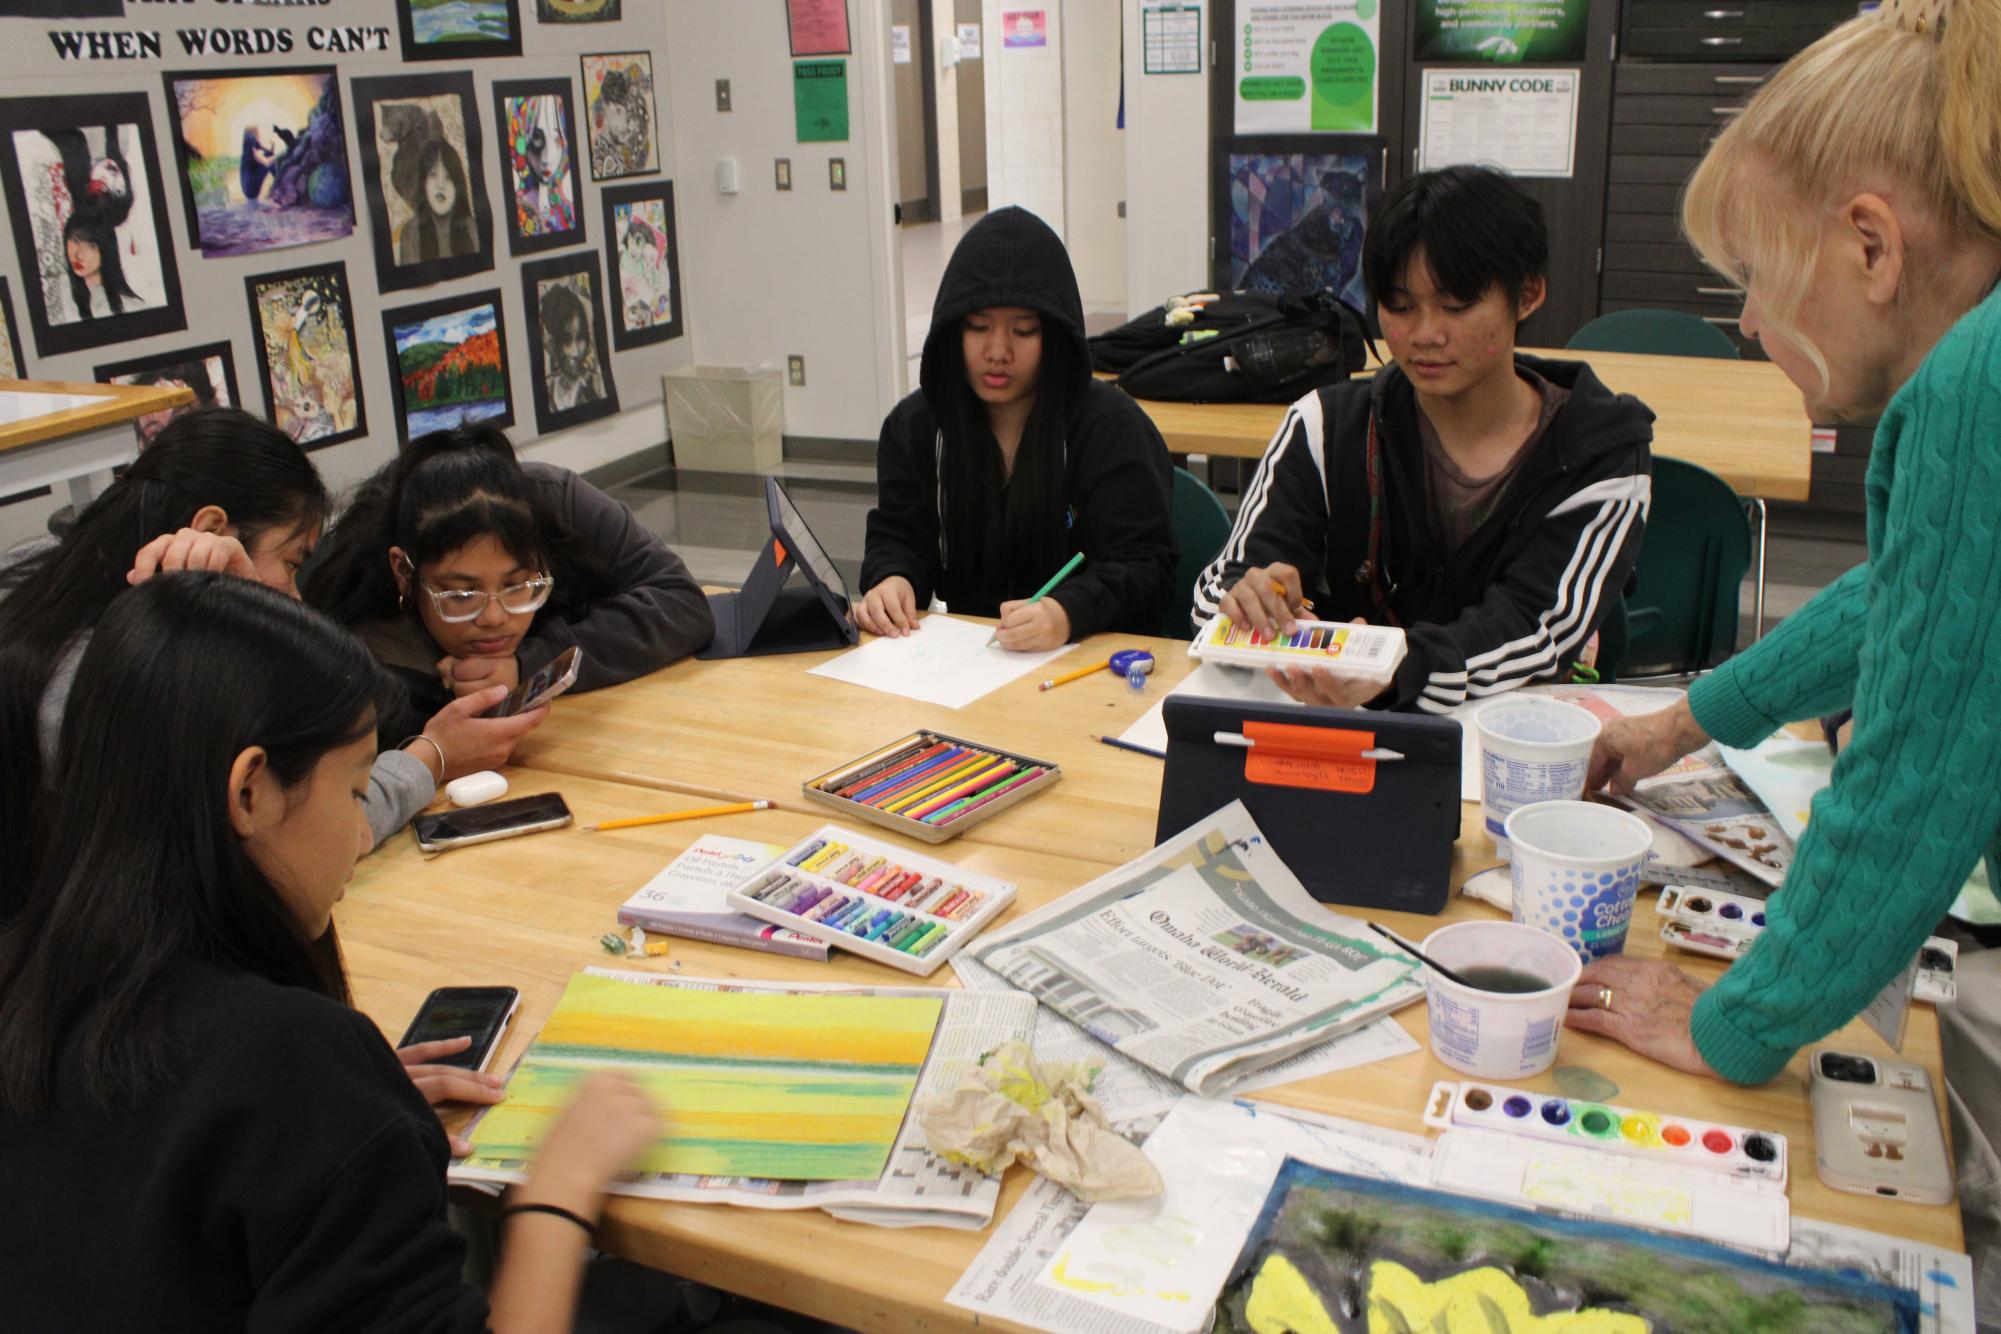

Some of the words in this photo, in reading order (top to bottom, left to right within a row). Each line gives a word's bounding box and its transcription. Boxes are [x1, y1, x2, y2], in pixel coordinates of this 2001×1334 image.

[48, 31, 162, 60] WHEN
[177, 27, 294, 56] WORDS
[307, 26, 390, 53] CAN'T
[1450, 79, 1506, 92] BUNNY
[1510, 79, 1553, 92] CODE
[639, 888, 668, 902] 36
[1100, 908, 1135, 937] Effort
[1131, 936, 1170, 960] targets
[1149, 910, 1201, 948] Omaha
[1200, 945, 1309, 1003] World-Herald
[975, 1278, 1002, 1303] Rare
